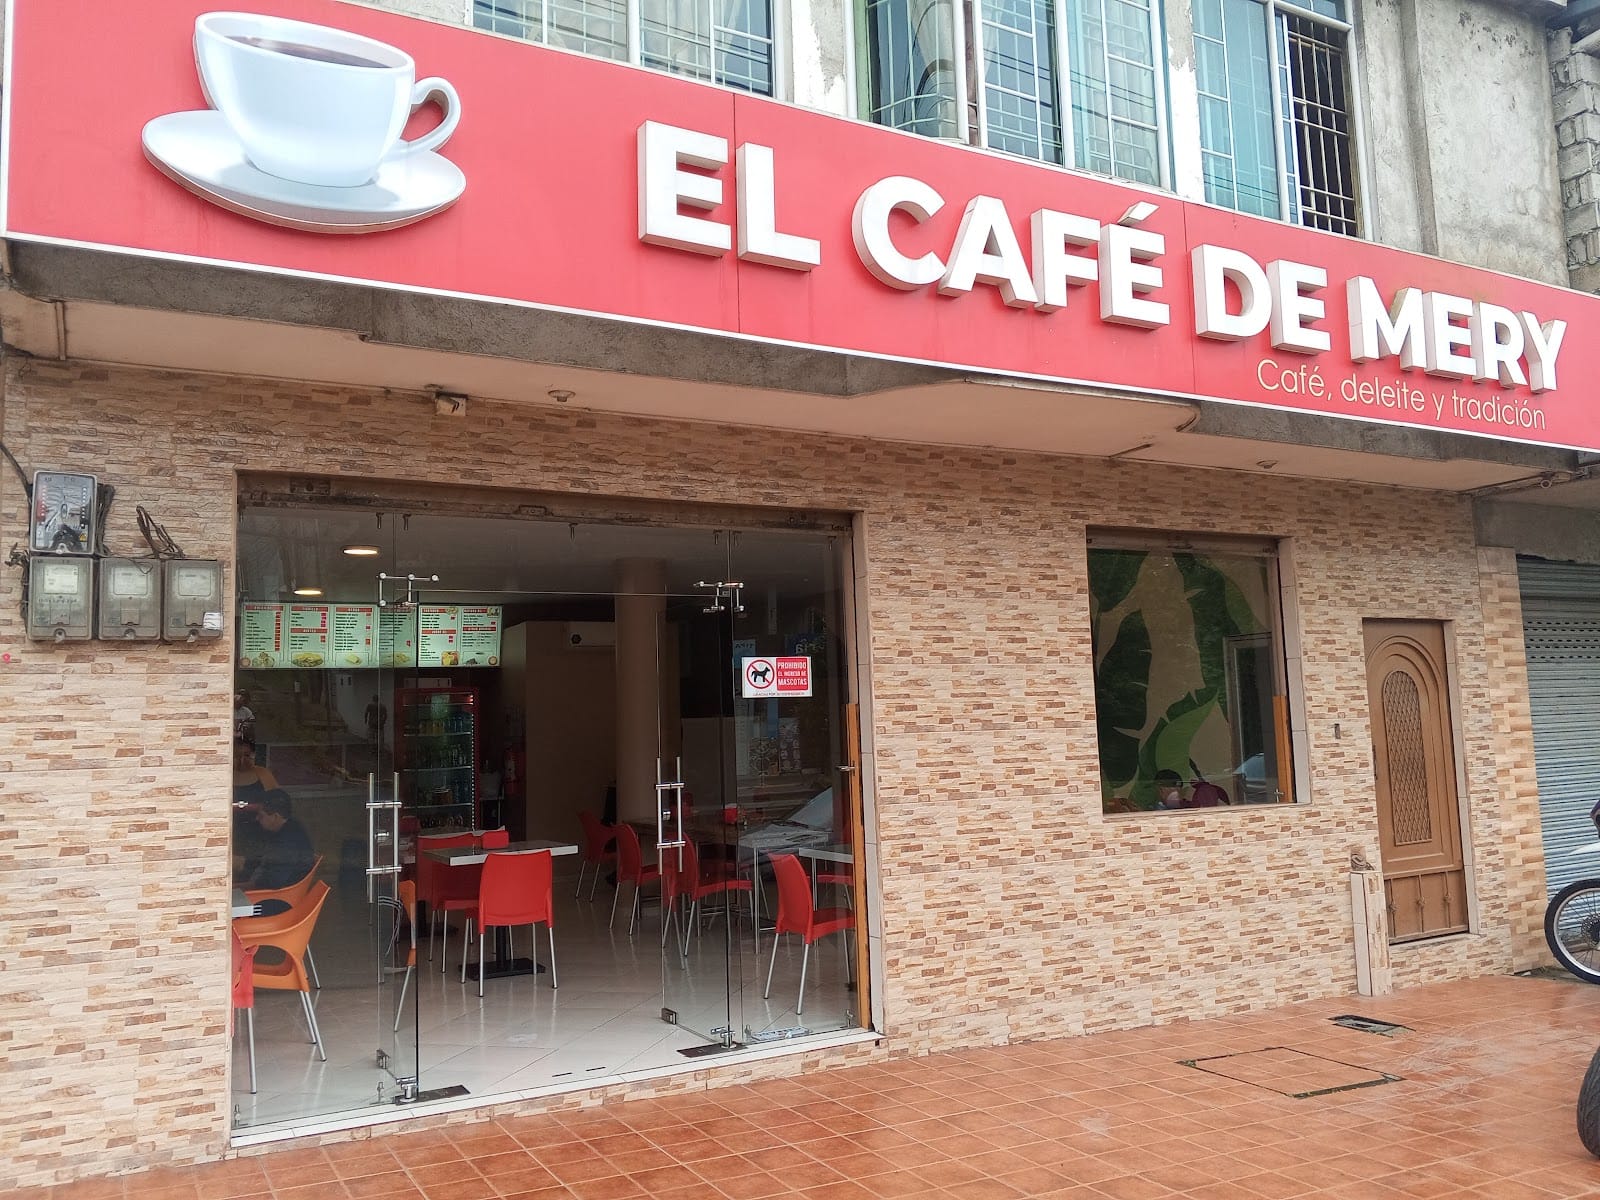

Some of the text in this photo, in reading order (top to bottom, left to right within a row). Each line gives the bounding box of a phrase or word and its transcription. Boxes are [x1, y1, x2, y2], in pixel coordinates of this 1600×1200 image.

[637, 119, 1567, 395] EL CAFÉ DE MERY
[1257, 359, 1547, 431] Café, deleite y tradición
[777, 661, 807, 670] PROHIBIDO
[778, 678, 807, 686] MASCOTAS
